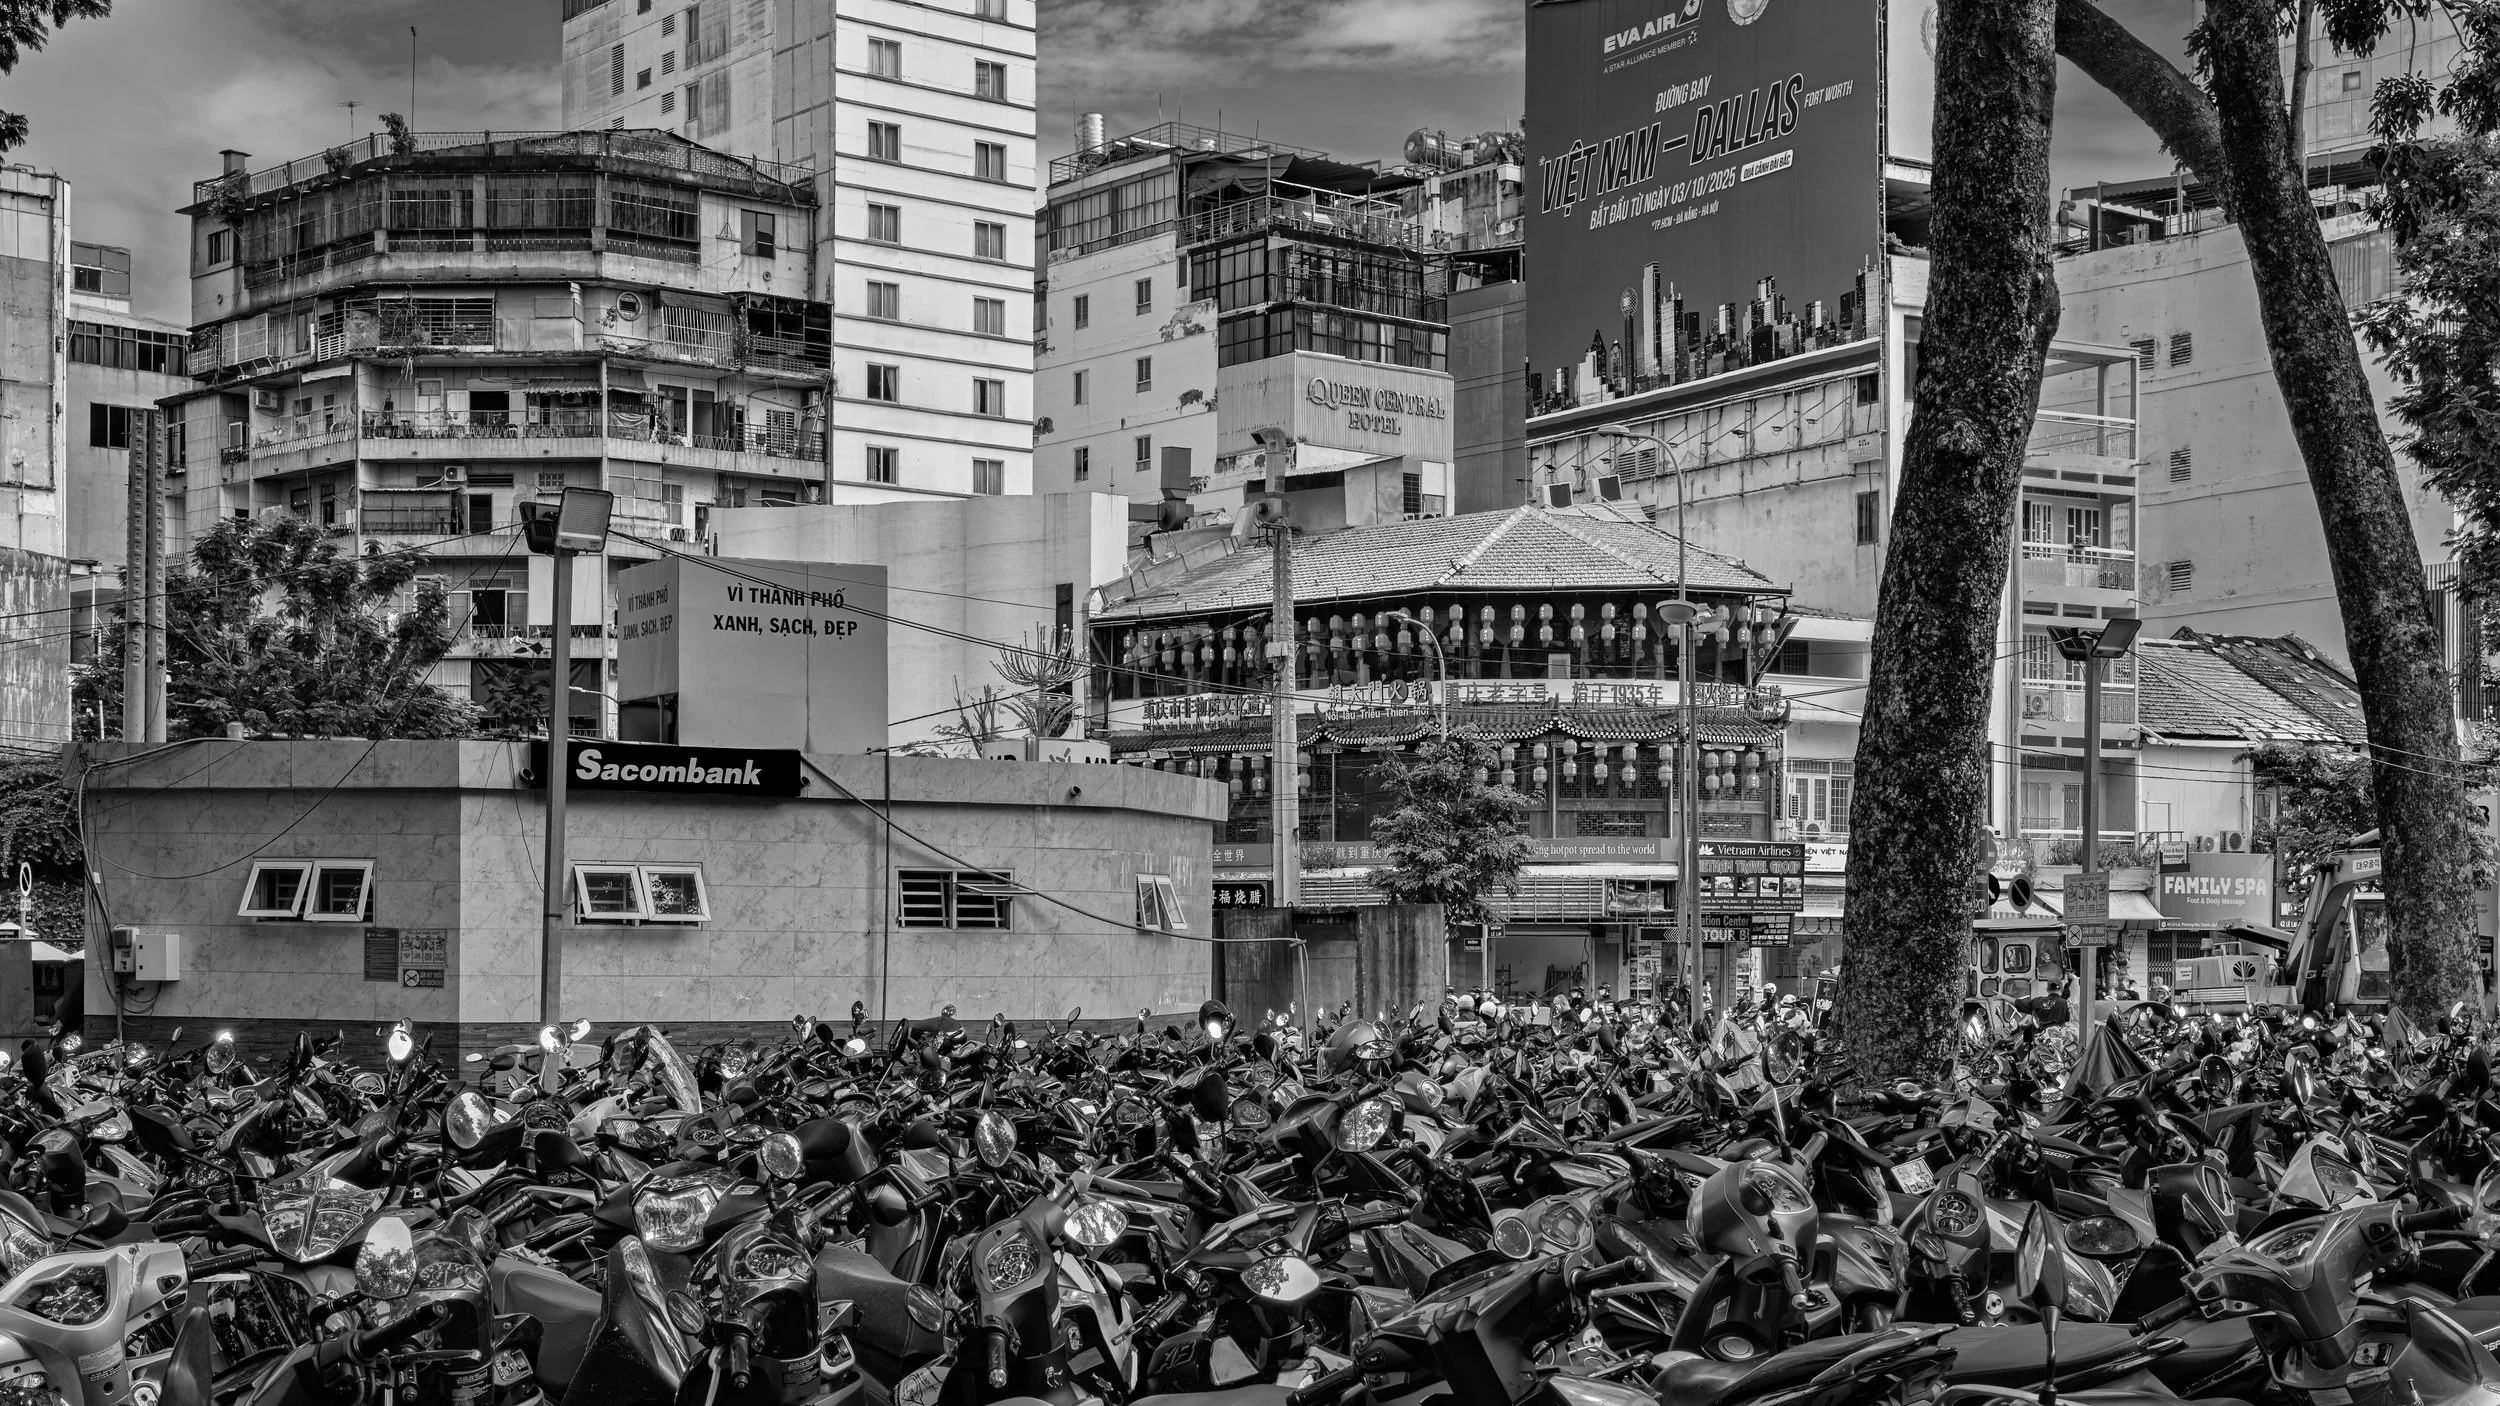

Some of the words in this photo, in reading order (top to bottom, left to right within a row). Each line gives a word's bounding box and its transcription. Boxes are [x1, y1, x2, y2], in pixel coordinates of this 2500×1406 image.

[1604, 27, 1641, 54] EVA
[1642, 12, 1676, 39] AIR
[1609, 60, 1625, 72] STAR
[1626, 49, 1657, 66] ALLIANCE
[1657, 38, 1686, 55] MEMBER
[1655, 84, 1689, 114] ĐƯỜNG
[1689, 75, 1712, 101] BAY
[1804, 89, 1825, 109] FORT
[1825, 79, 1854, 103] WORTH
[1597, 121, 1661, 196] NAM
[1689, 73, 1804, 166] DALLAS
[1590, 200, 1609, 230] BẮT
[1609, 195, 1631, 225] ĐẦU
[1630, 192, 1644, 217] TỪ
[1643, 185, 1671, 214] NGÀY
[1671, 166, 1737, 205] 03/10/2025
[1306, 377, 1371, 410] QUEEN
[1375, 388, 1445, 419] CENTRAL
[1349, 411, 1401, 435] HOTEL
[727, 582, 743, 602] VÌ
[811, 587, 847, 609] PHỐ
[713, 615, 763, 635] XANH,
[769, 617, 818, 638] SẠCH,
[824, 620, 858, 640] ĐẸP
[1445, 682, 1549, 704] 重庆老字号
[576, 748, 762, 785] Sacombank
[1550, 843, 1577, 857] hotpot
[1579, 843, 1604, 857] spread
[1607, 844, 1616, 855] to
[1618, 844, 1631, 855] the
[1632, 843, 1656, 855] world
[1717, 844, 1755, 856] Vietnam
[1757, 845, 1792, 857] Airlines
[1735, 860, 1768, 875] TRAVEL
[1769, 861, 1801, 876] GROUP
[2165, 876, 2232, 895] FAMILY
[2234, 877, 2267, 896] SPA
[2206, 898, 2220, 906] Body
[2221, 898, 2246, 906] Massage
[1723, 915, 1750, 927] Center
[1702, 929, 1736, 941] TOUR
